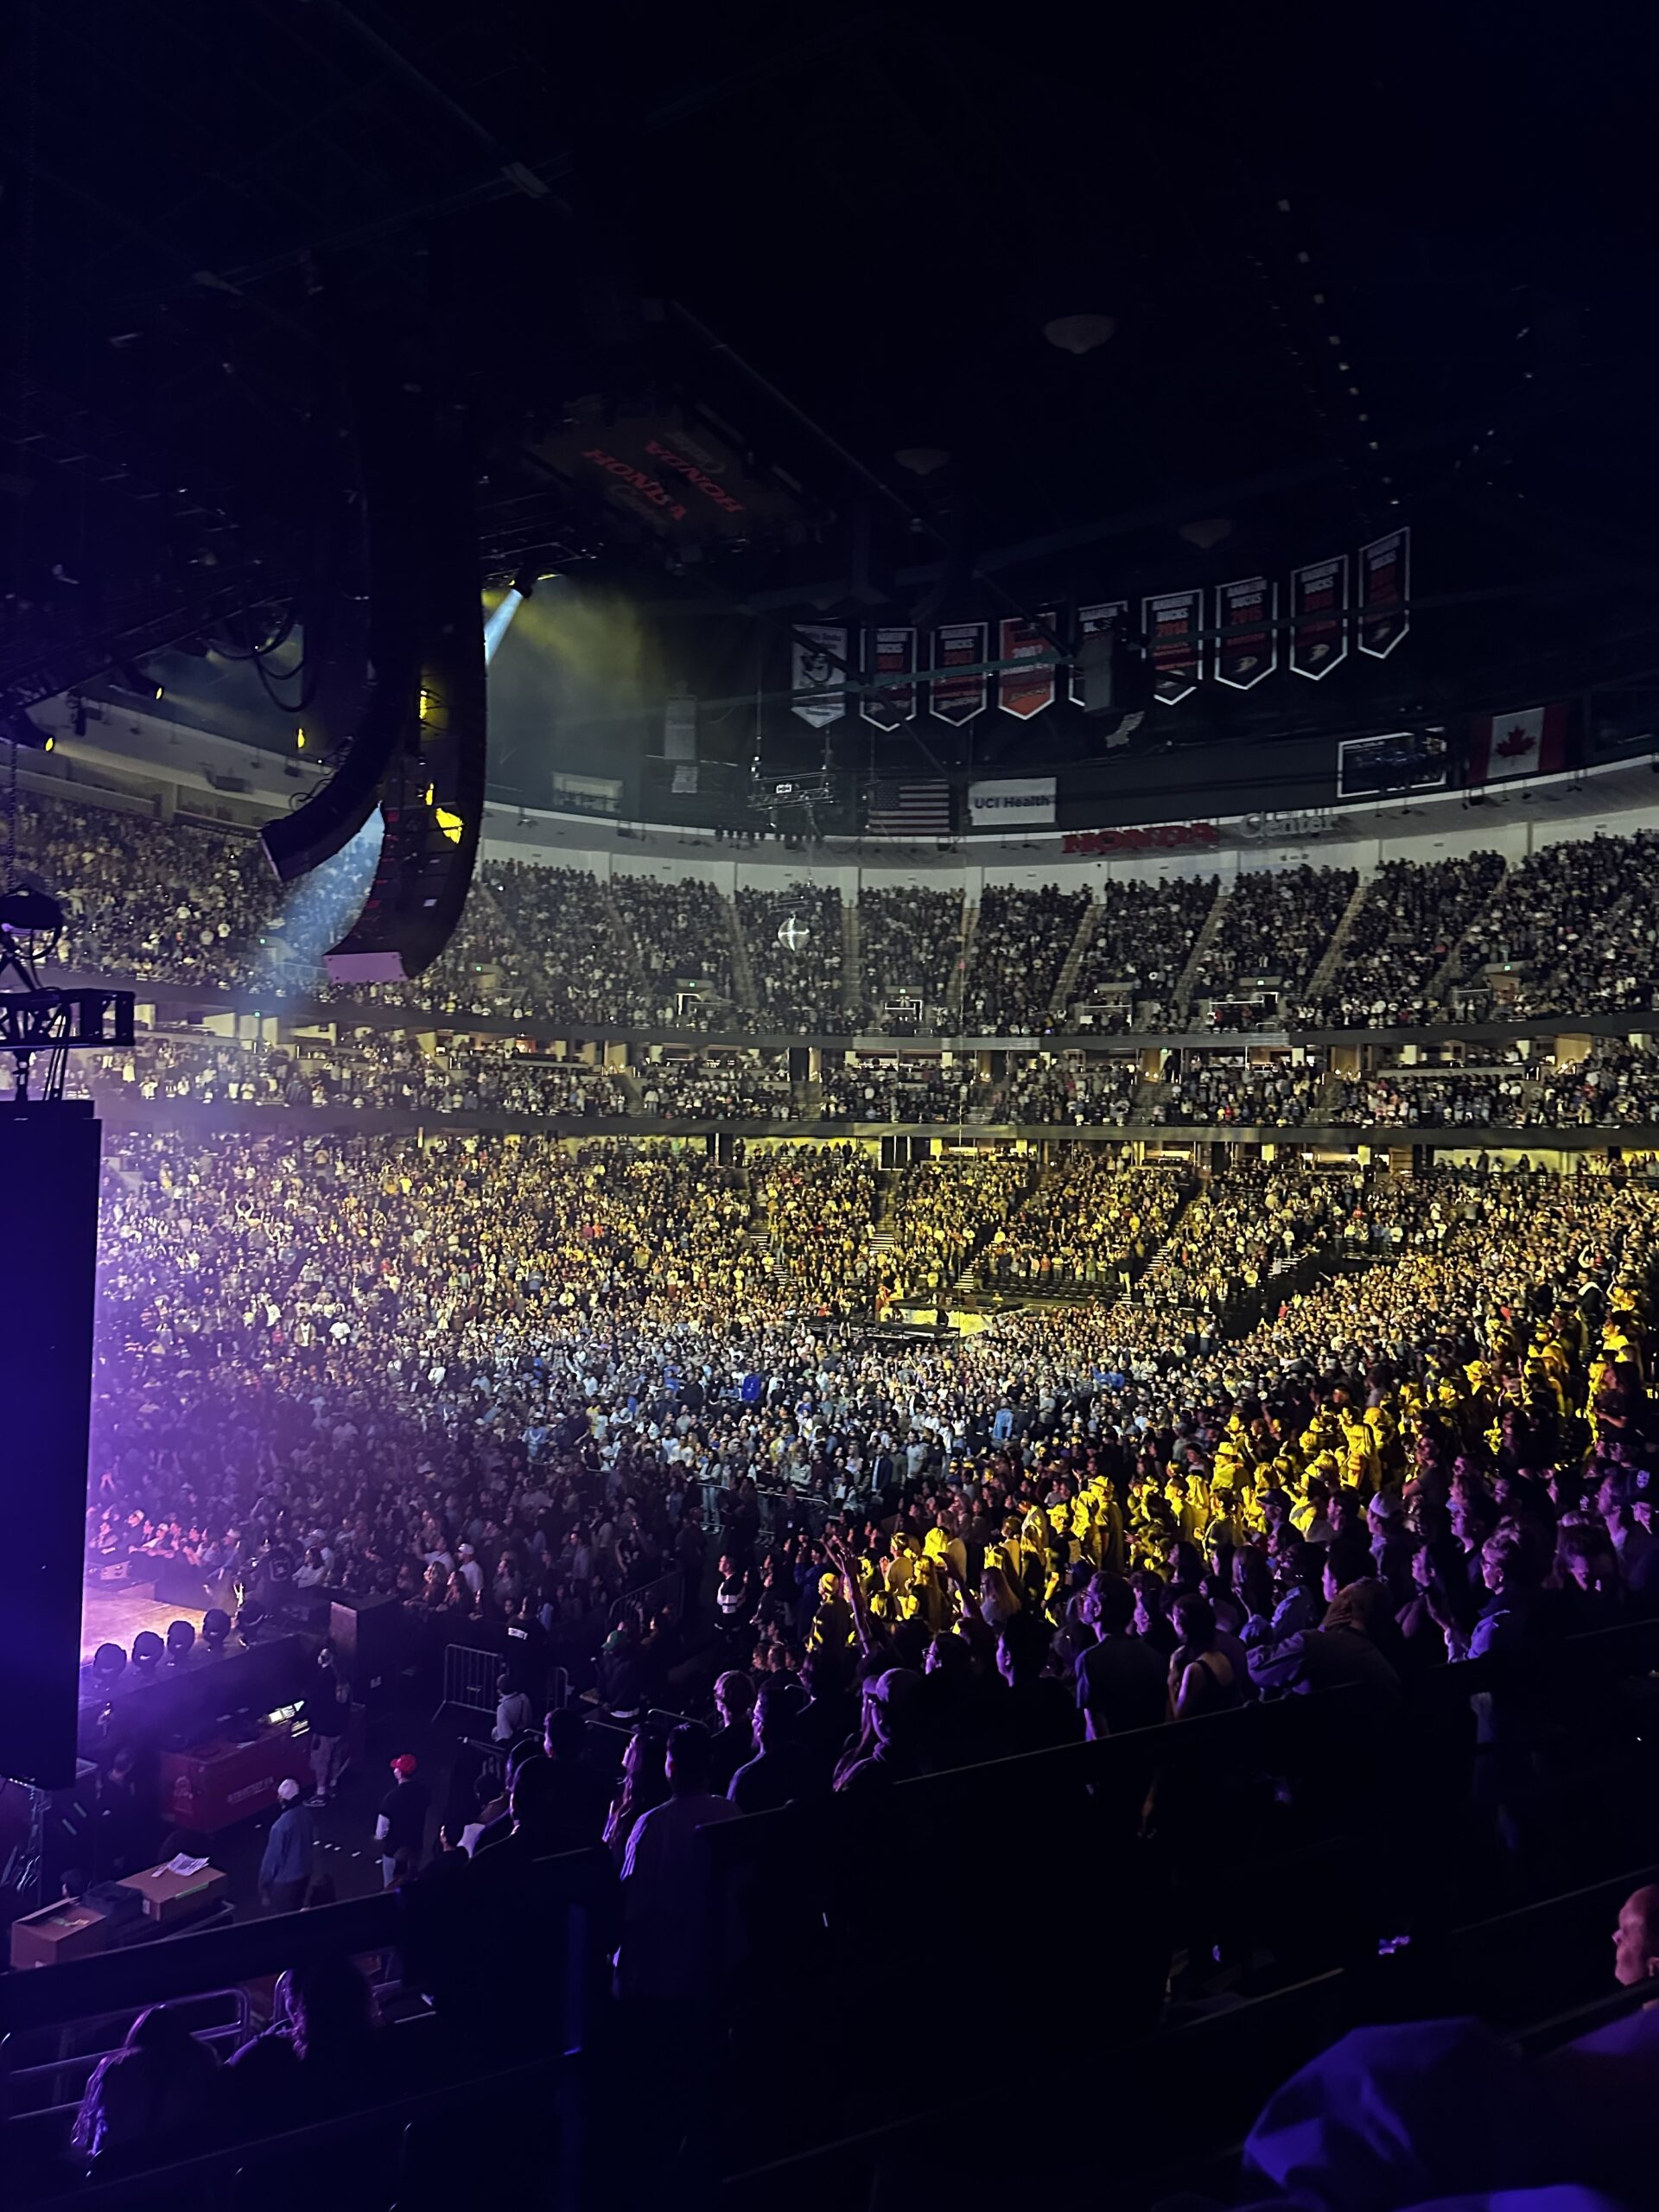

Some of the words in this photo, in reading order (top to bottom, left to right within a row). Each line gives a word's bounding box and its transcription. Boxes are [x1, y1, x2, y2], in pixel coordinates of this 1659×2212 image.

[645, 439, 746, 512] HONDA
[975, 798, 1000, 809] UCI
[1003, 795, 1050, 808] Health
[1061, 823, 1218, 854] HONDA
[1239, 812, 1339, 838] Center
